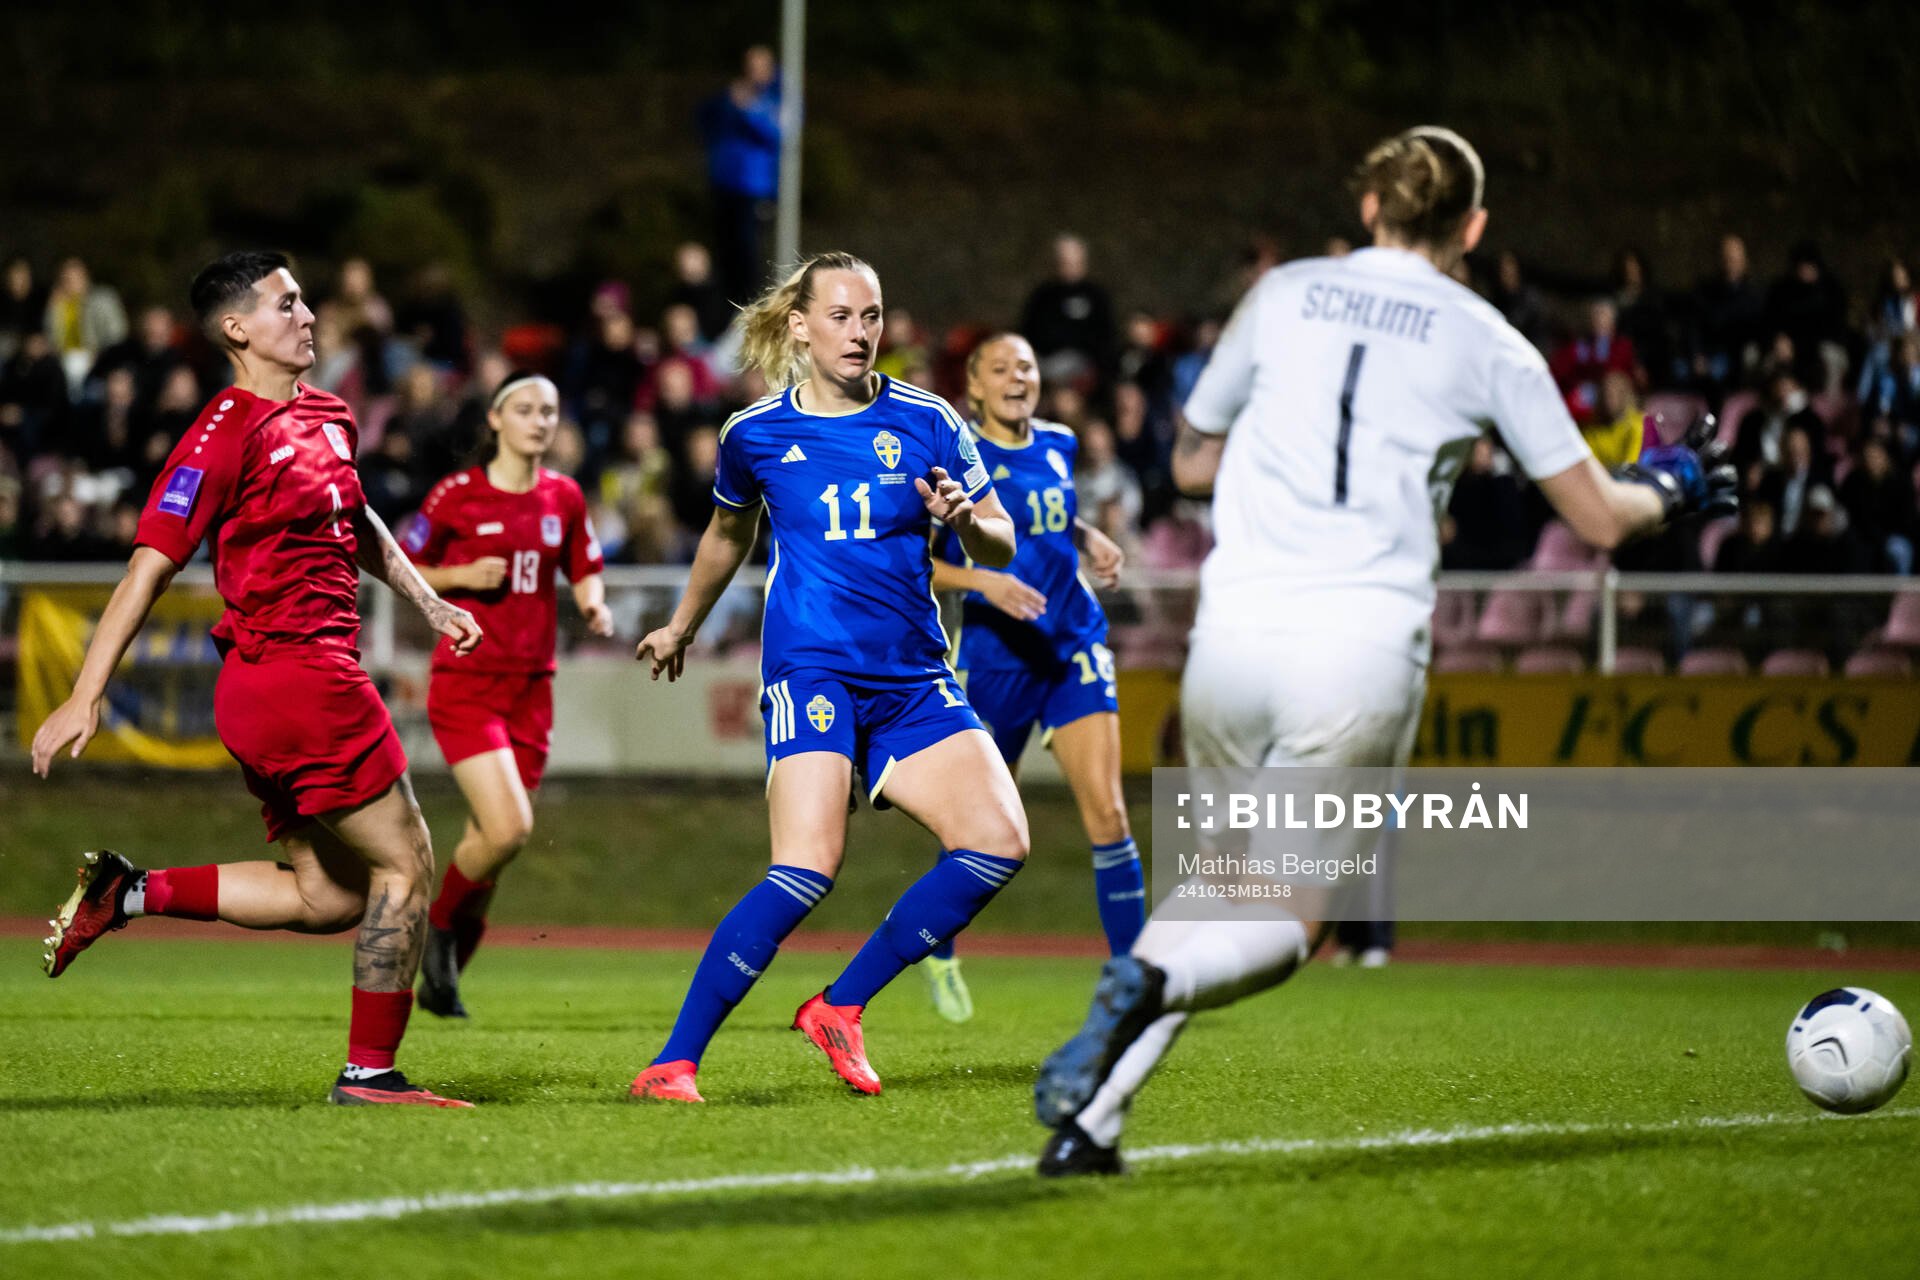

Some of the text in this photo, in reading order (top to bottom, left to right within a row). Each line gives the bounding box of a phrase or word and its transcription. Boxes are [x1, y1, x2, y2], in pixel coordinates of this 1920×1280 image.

[1301, 283, 1437, 343] SCHLIME
[1333, 343, 1367, 504] 1
[819, 482, 876, 541] 11
[1026, 487, 1068, 536] 18
[512, 550, 541, 594] 13
